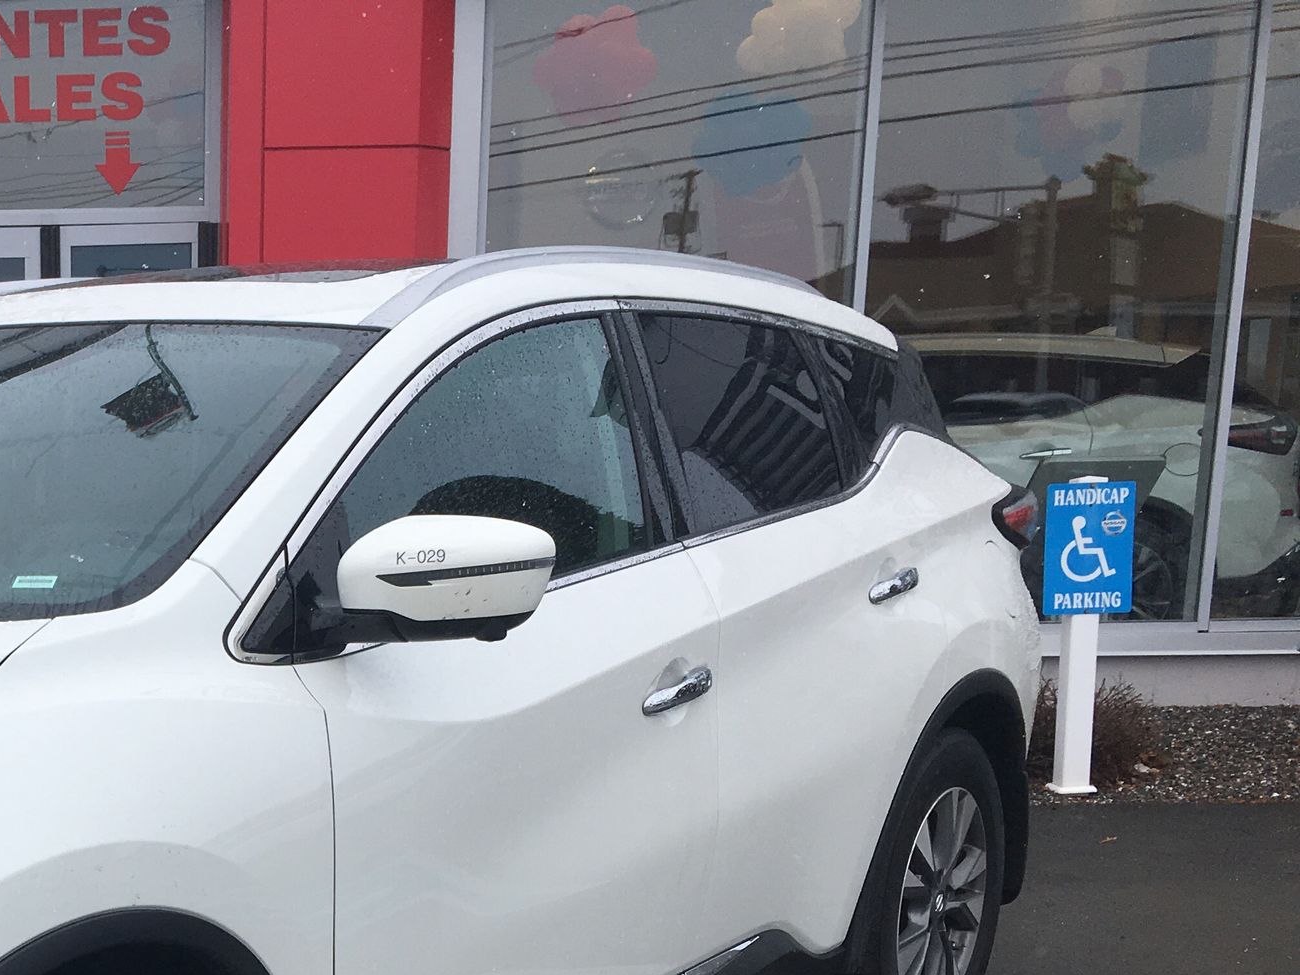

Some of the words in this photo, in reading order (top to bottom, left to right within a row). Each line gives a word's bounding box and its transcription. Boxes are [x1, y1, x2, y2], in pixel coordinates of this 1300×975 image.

[1054, 487, 1130, 506] HANDICAP
[396, 549, 446, 565] K-029
[1053, 592, 1122, 610] PARKING
